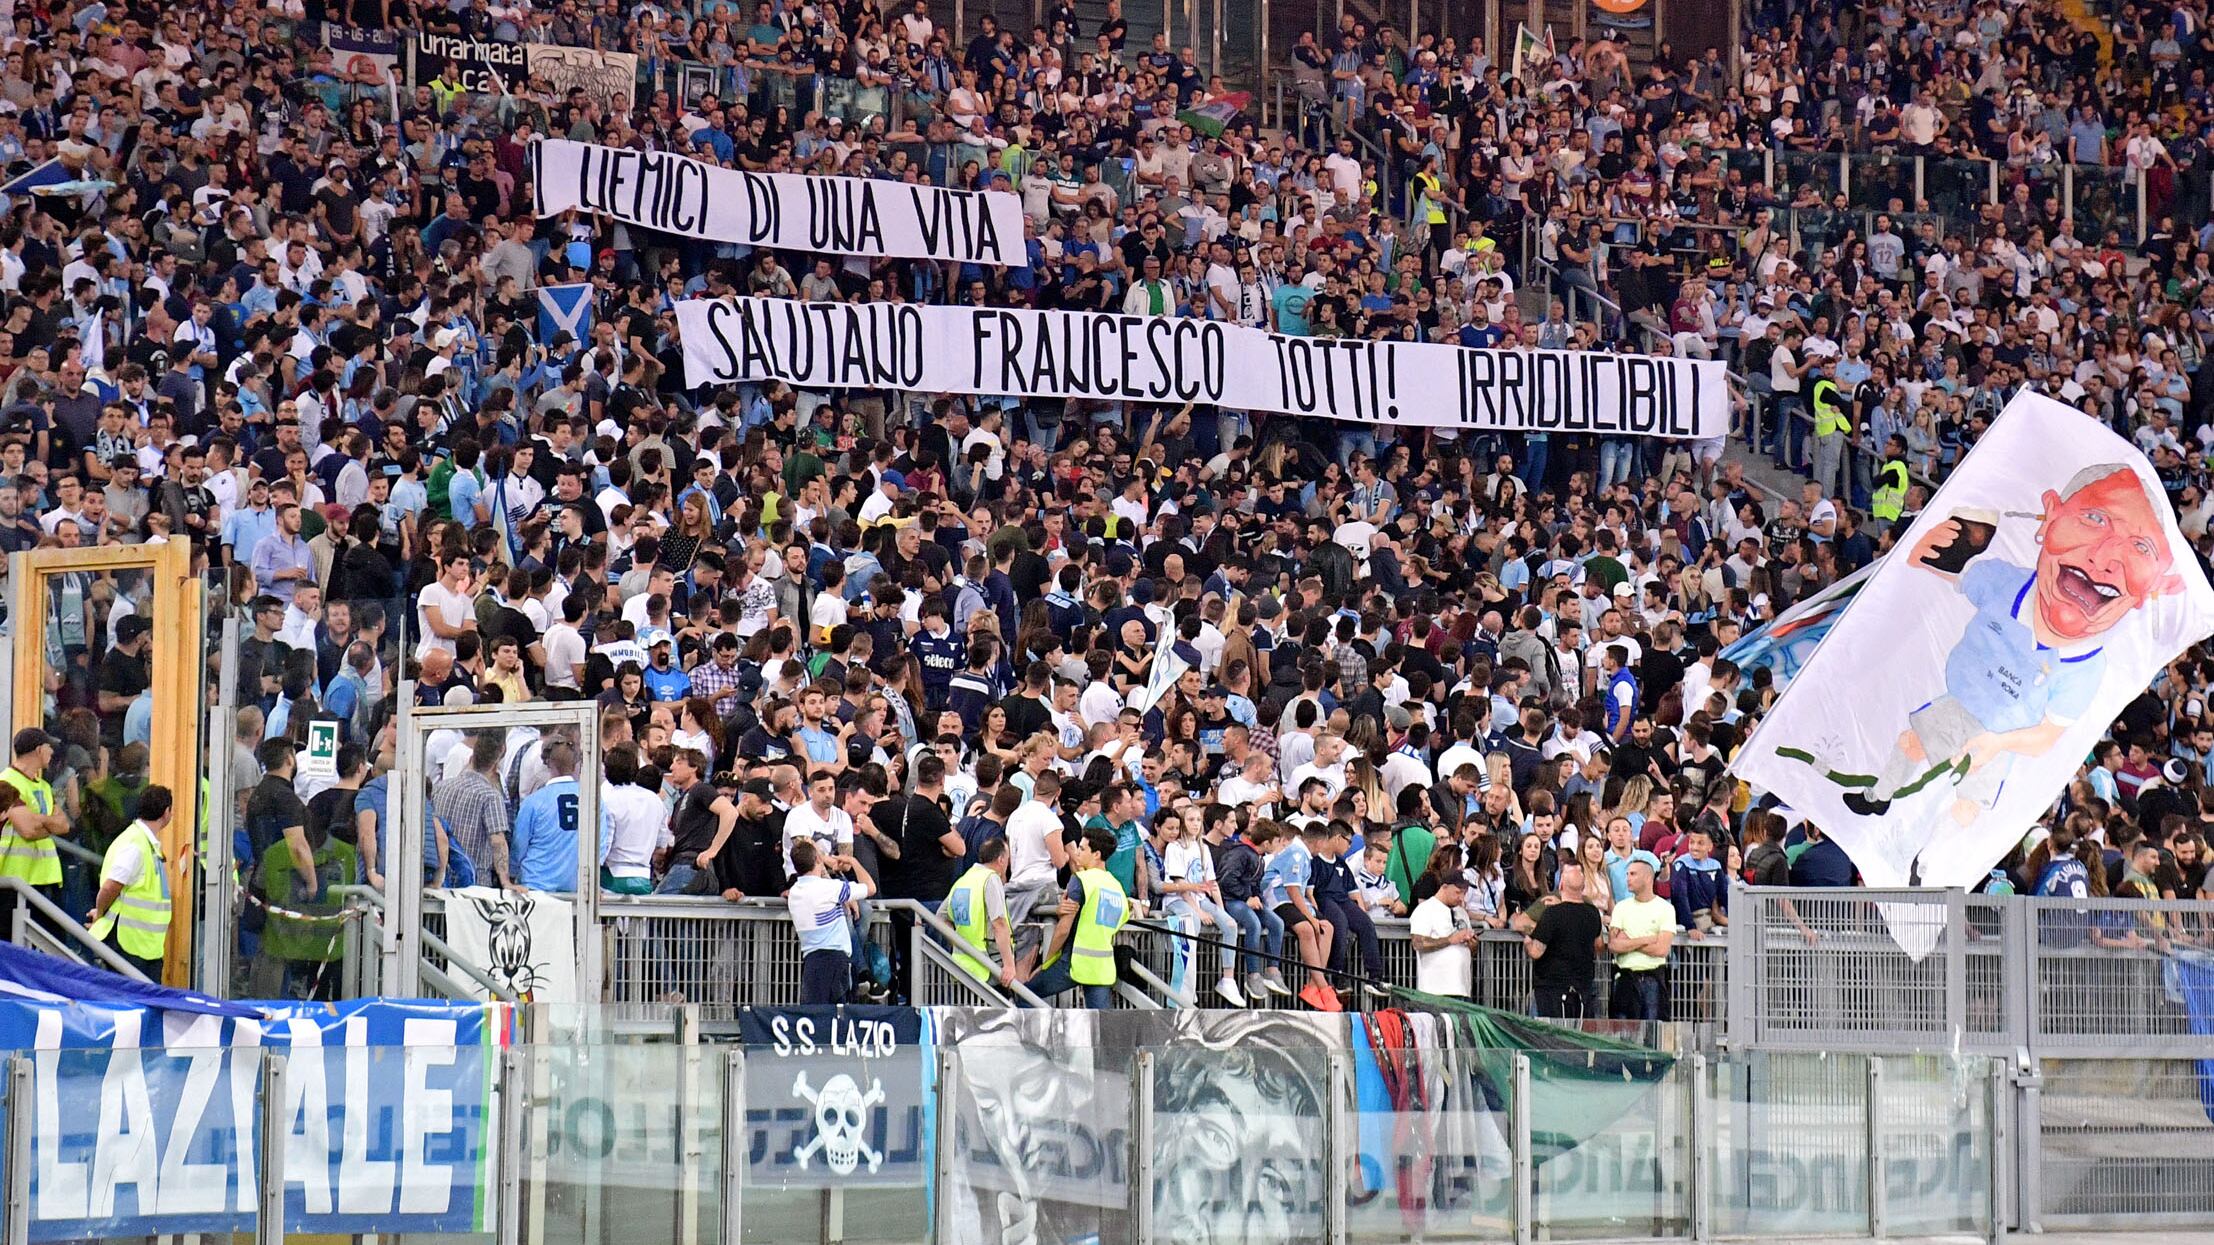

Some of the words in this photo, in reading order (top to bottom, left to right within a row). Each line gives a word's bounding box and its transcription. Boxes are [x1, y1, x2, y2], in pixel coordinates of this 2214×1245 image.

[534, 140, 546, 215] I
[744, 170, 780, 244] DI
[806, 177, 884, 253] UNA
[910, 186, 1002, 262] VITA
[707, 301, 924, 388] SALUTANO
[973, 310, 1225, 402] FRANCESCO
[1268, 334, 1400, 419] TOTTI!
[1458, 348, 1700, 436] IRRIDUCIBILI
[1998, 665, 2023, 687] BANCA
[2001, 681, 2020, 700] ROMA
[556, 793, 579, 832] 6
[771, 1015, 823, 1057] S.S.
[830, 1017, 897, 1059] LAZIO
[34, 1008, 458, 1219] LAZIALE
